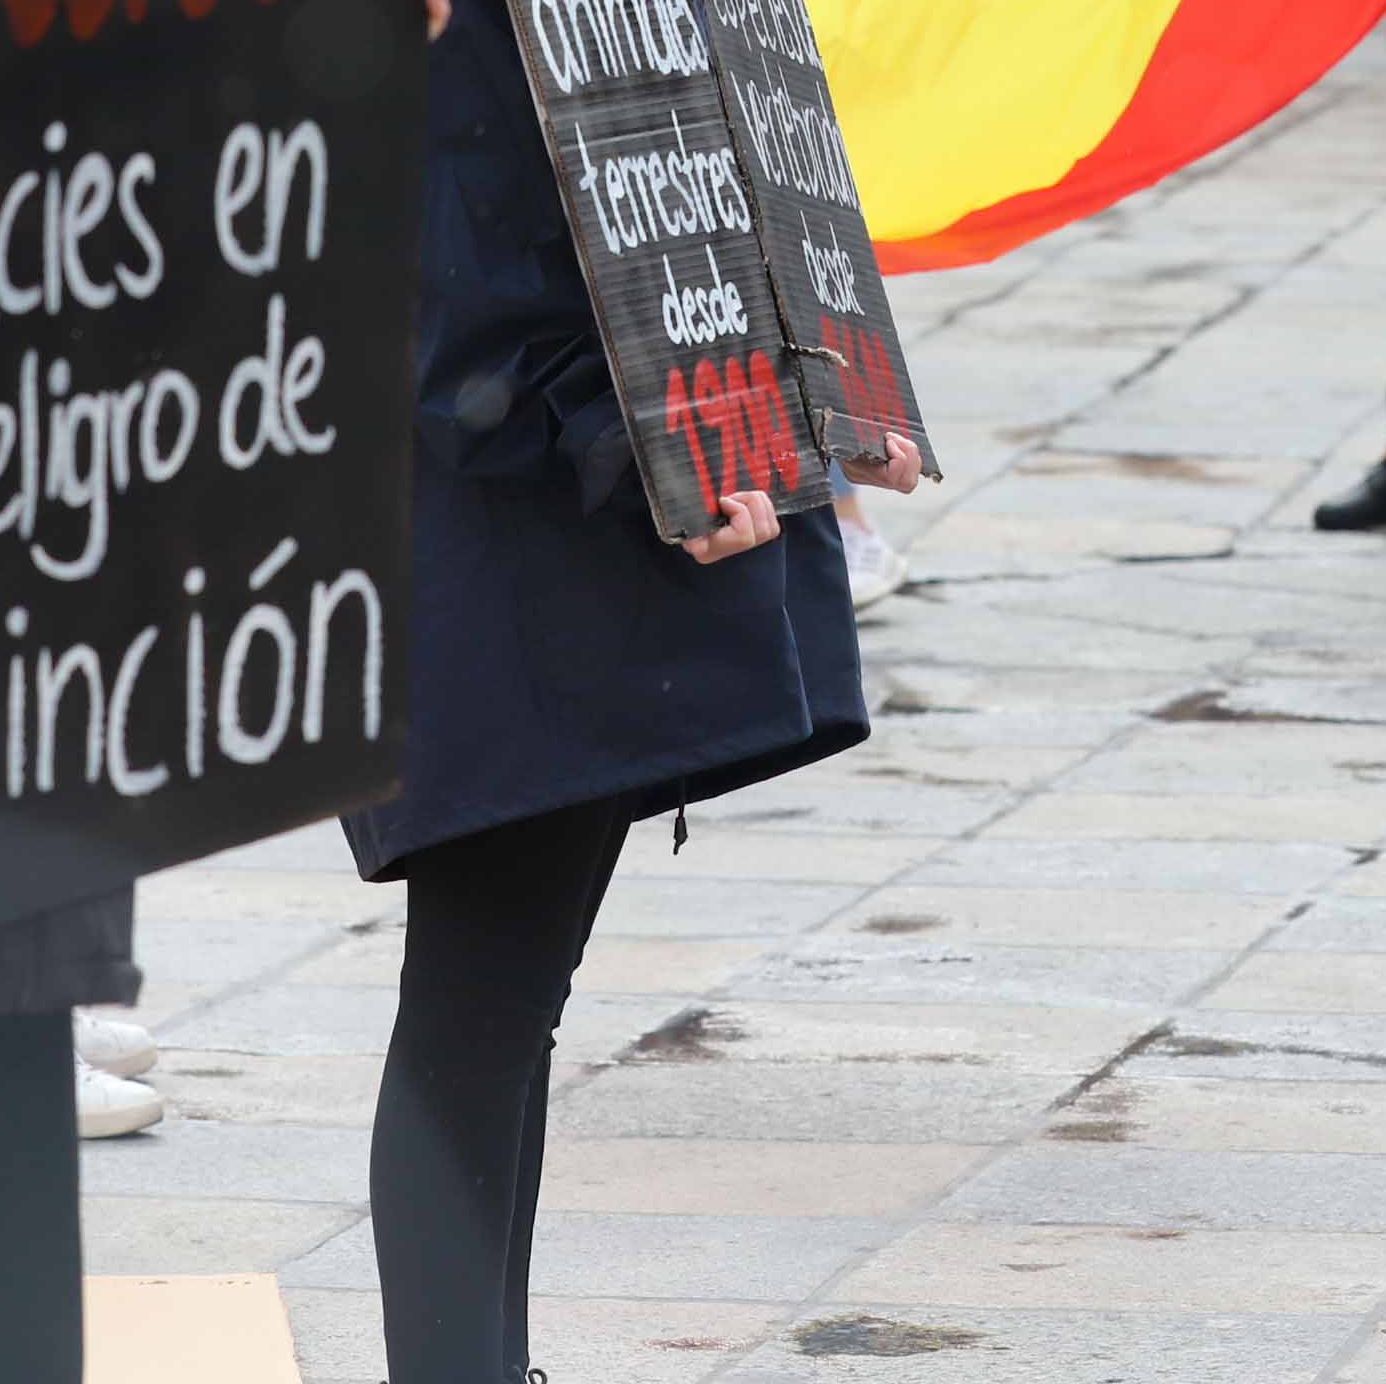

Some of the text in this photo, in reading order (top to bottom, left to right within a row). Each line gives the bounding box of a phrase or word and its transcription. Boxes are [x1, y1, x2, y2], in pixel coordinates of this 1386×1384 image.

[215, 120, 329, 277] en
[575, 107, 751, 257] terrestres
[662, 242, 749, 348] desde
[799, 209, 866, 317] desde
[218, 292, 337, 471] de
[665, 348, 801, 515] 1900
